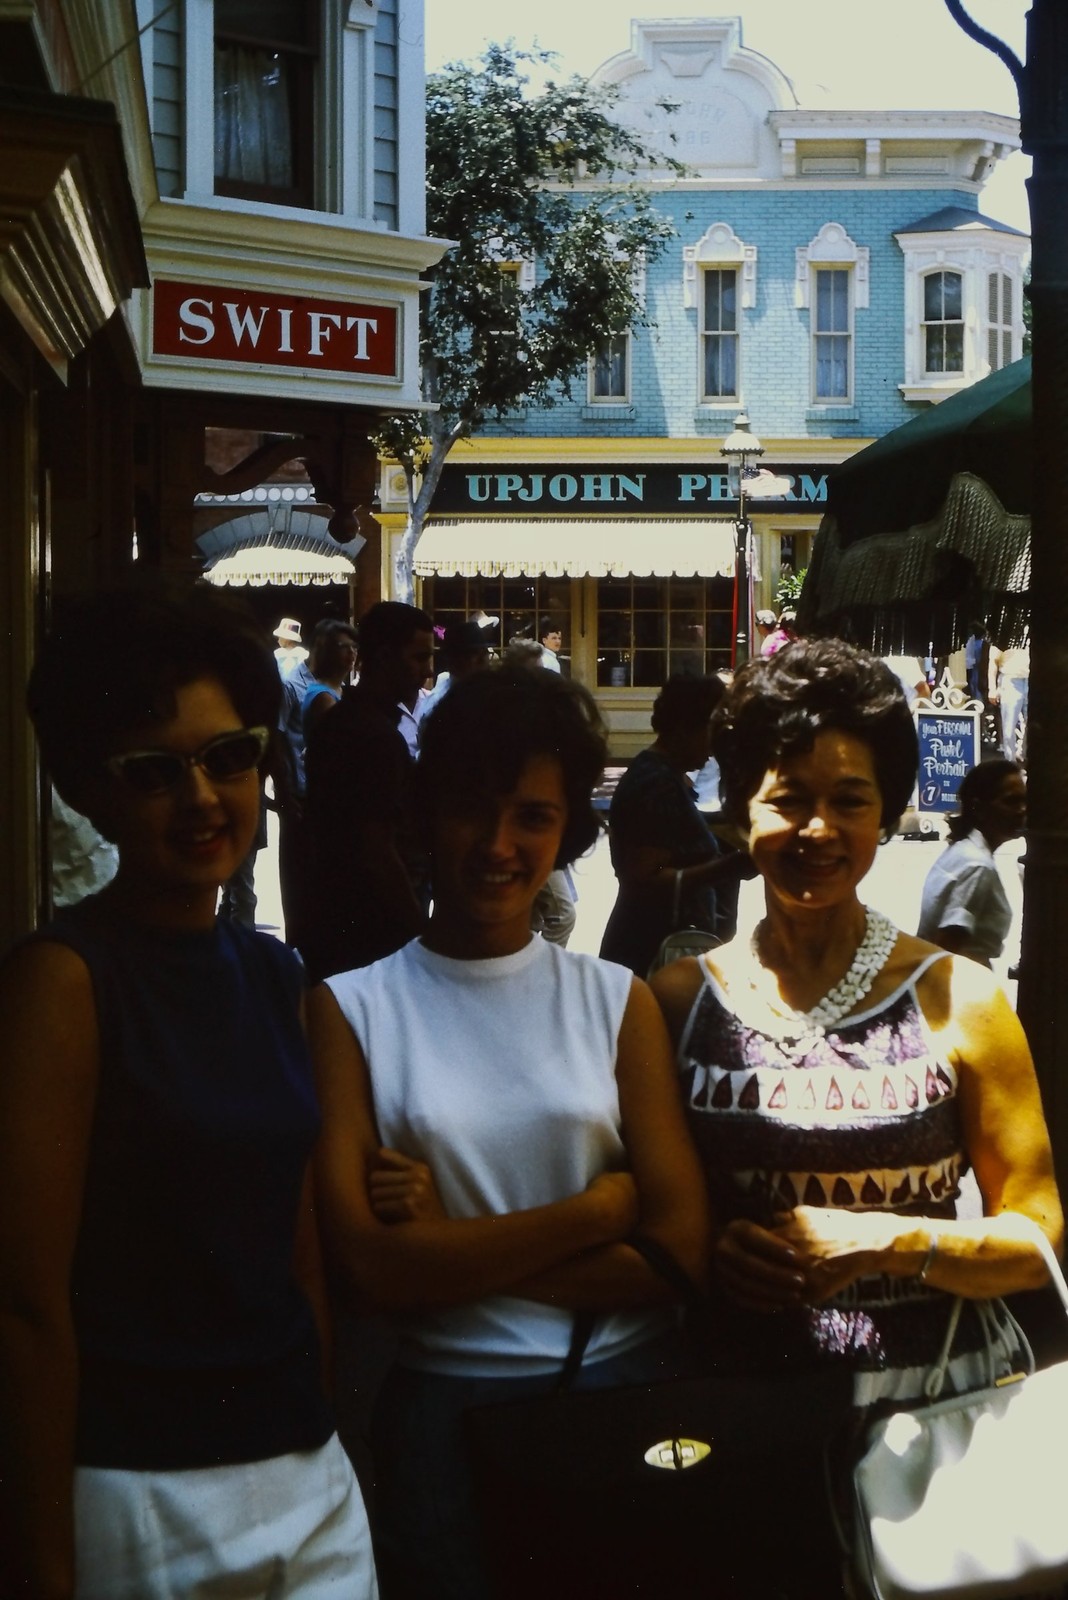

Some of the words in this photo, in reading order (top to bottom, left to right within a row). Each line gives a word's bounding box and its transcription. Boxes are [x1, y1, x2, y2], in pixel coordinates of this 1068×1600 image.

[179, 298, 378, 360] SWIFT
[465, 474, 646, 501] UPJOHN
[929, 738, 964, 758] Pastel
[924, 756, 968, 776] Portrait
[927, 786, 936, 801] 7
